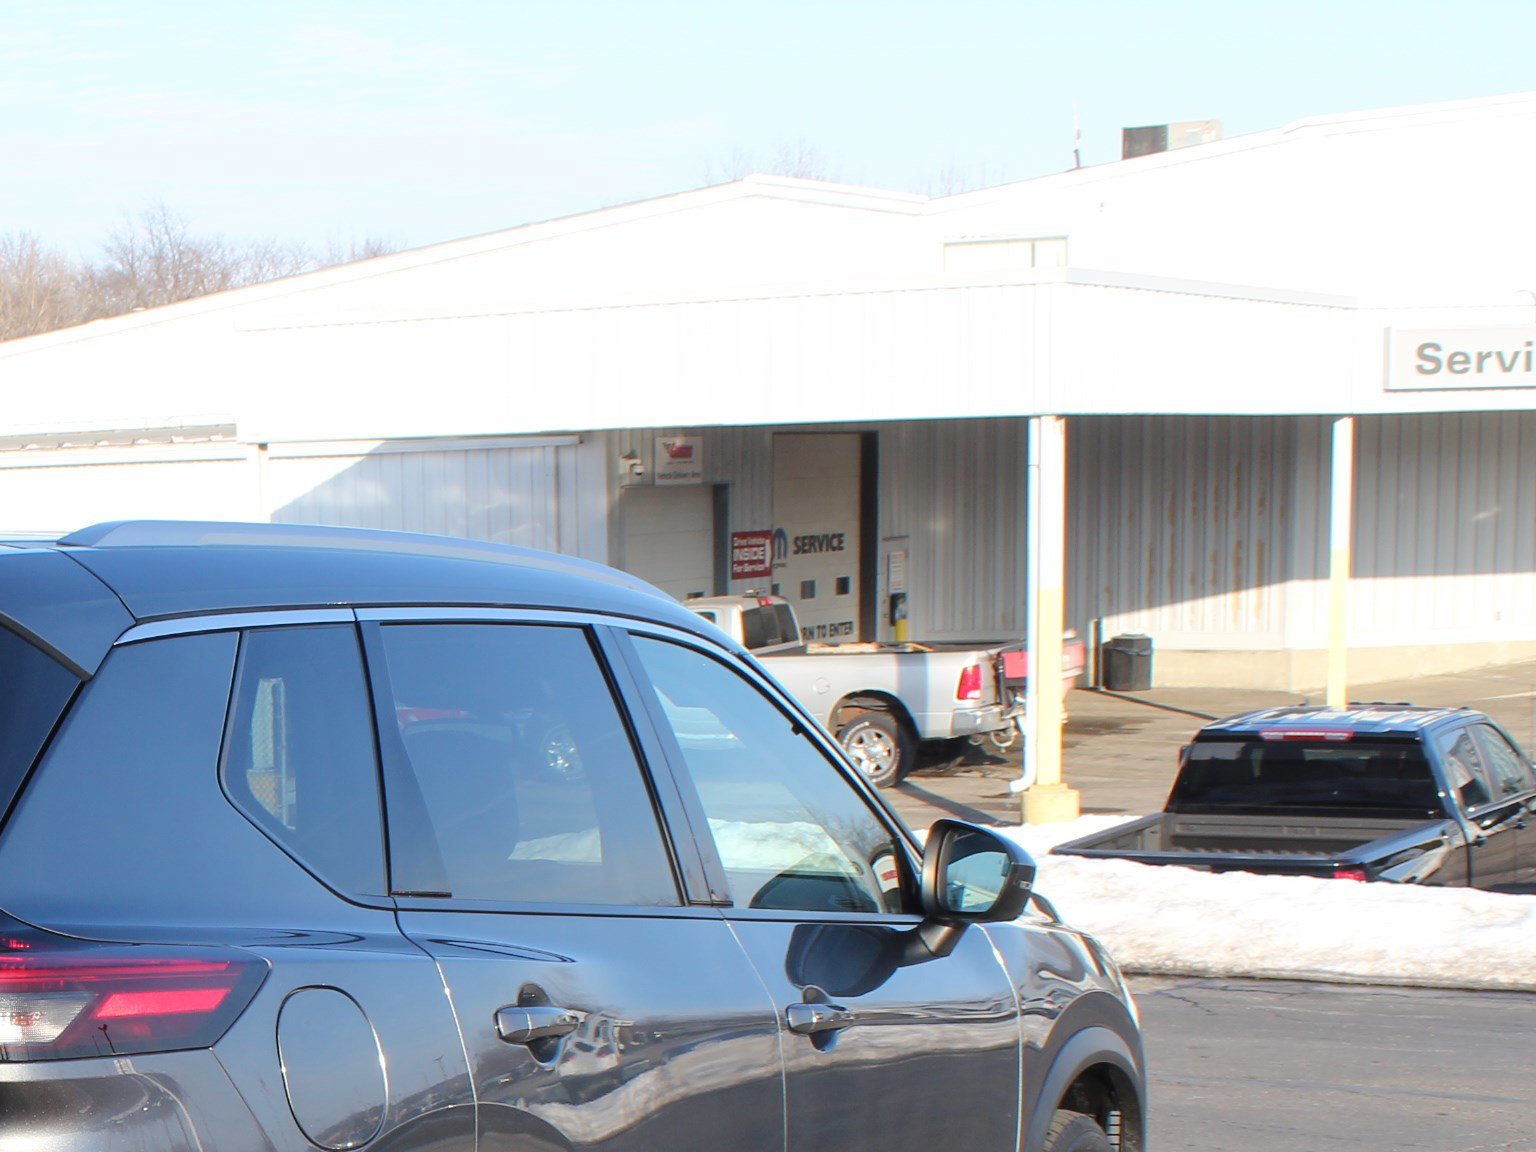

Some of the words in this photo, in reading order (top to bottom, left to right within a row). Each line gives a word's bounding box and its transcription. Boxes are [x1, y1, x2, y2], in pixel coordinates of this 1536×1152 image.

[1415, 340, 1535, 375] Servi
[793, 533, 844, 555] SERVICE
[733, 547, 765, 561] INSIDE
[817, 624, 827, 638] TO
[829, 621, 853, 637] ENTER
